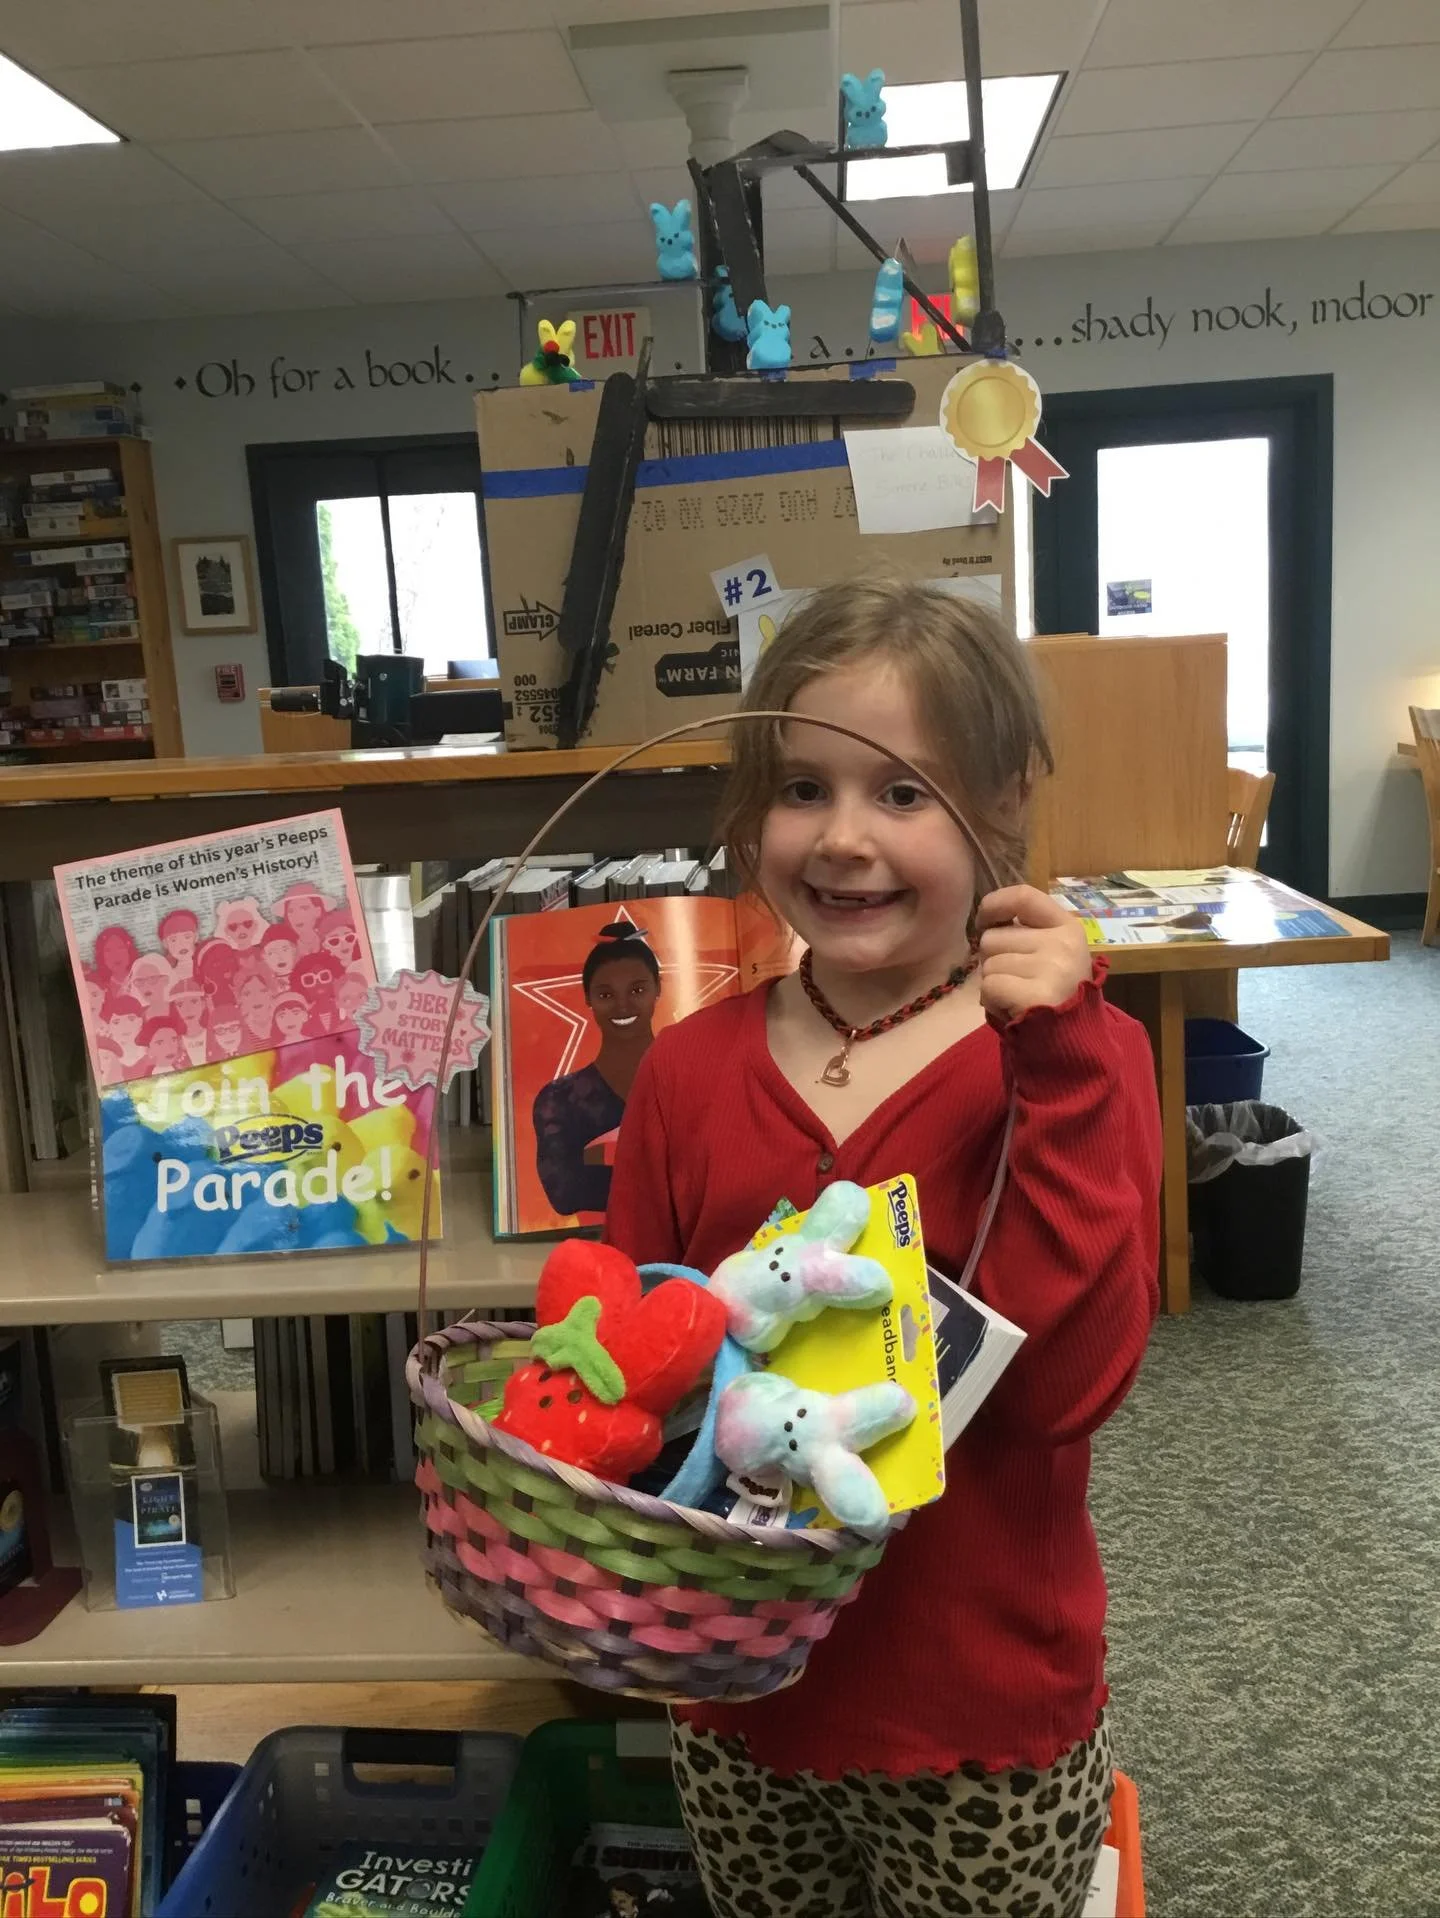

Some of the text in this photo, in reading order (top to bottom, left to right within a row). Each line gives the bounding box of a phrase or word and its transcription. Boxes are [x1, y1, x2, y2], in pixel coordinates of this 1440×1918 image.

[1192, 287, 1298, 336] nook,
[1311, 280, 1435, 326] indoor
[583, 313, 637, 359] EXIT
[196, 359, 255, 398] Oh
[270, 356, 320, 399] for
[333, 366, 355, 391] a
[724, 569, 772, 606] #2
[509, 613, 555, 630] CLAMP
[629, 620, 731, 641] Fiber Cereal
[75, 826, 329, 891] The theme of this year's Peeps
[93, 850, 320, 910] Parade is Women's History!
[407, 991, 448, 1015] HER
[381, 1028, 465, 1056] MATTES
[136, 1055, 407, 1123] Join the
[215, 1122, 324, 1162] Peeps
[157, 1147, 392, 1213] Parade!
[889, 1181, 911, 1248] Peeps
[881, 1300, 899, 1384] eadban
[359, 1851, 473, 1877] Investi
